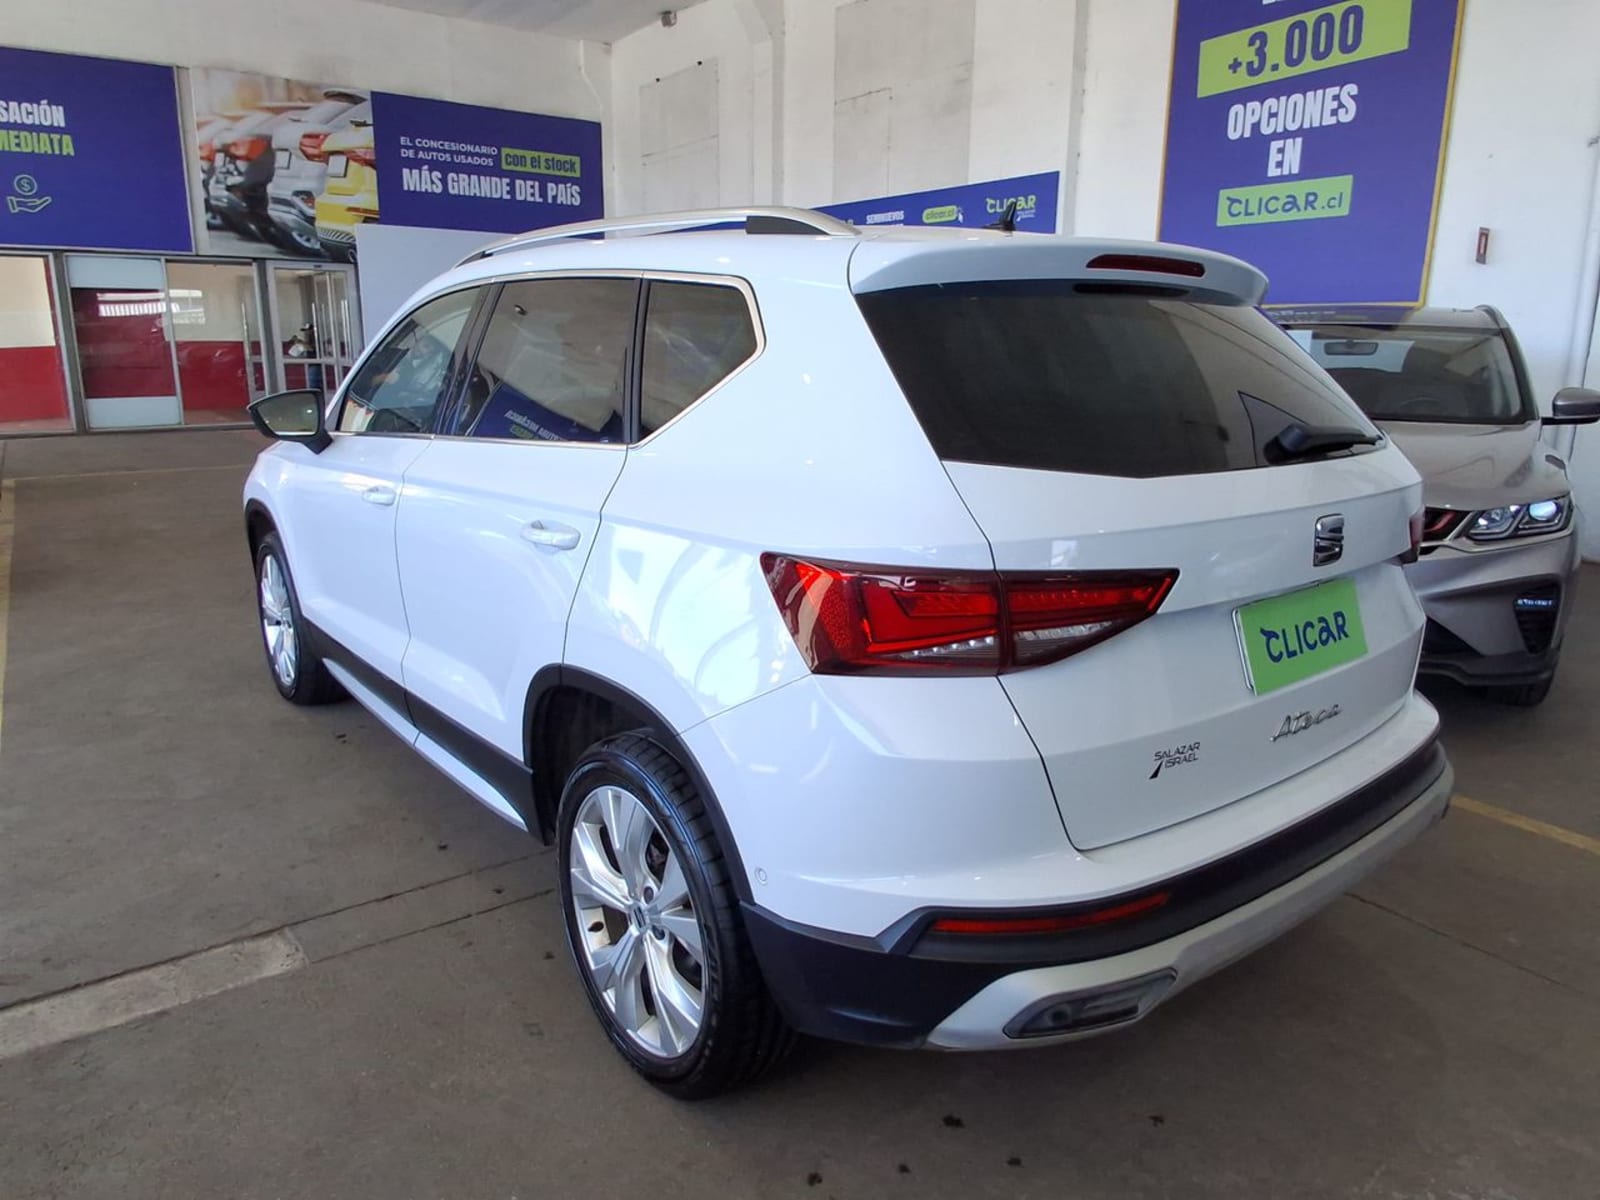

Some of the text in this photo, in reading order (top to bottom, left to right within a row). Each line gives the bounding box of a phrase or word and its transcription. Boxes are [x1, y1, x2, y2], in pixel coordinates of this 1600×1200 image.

[1227, 4, 1364, 77] +3.000
[1226, 83, 1359, 140] OPCIONES
[400, 136, 498, 155] EL CONCESIONARIO
[401, 149, 494, 167] DE AUTOS USADOS
[504, 152, 577, 174] con el stock
[1267, 137, 1303, 177] EN
[402, 164, 443, 194] MÁS
[447, 172, 511, 200] GRANDE
[515, 179, 543, 203] DEL
[1154, 741, 1200, 762] SALAZAR
[1164, 753, 1199, 768] ISRAEL
